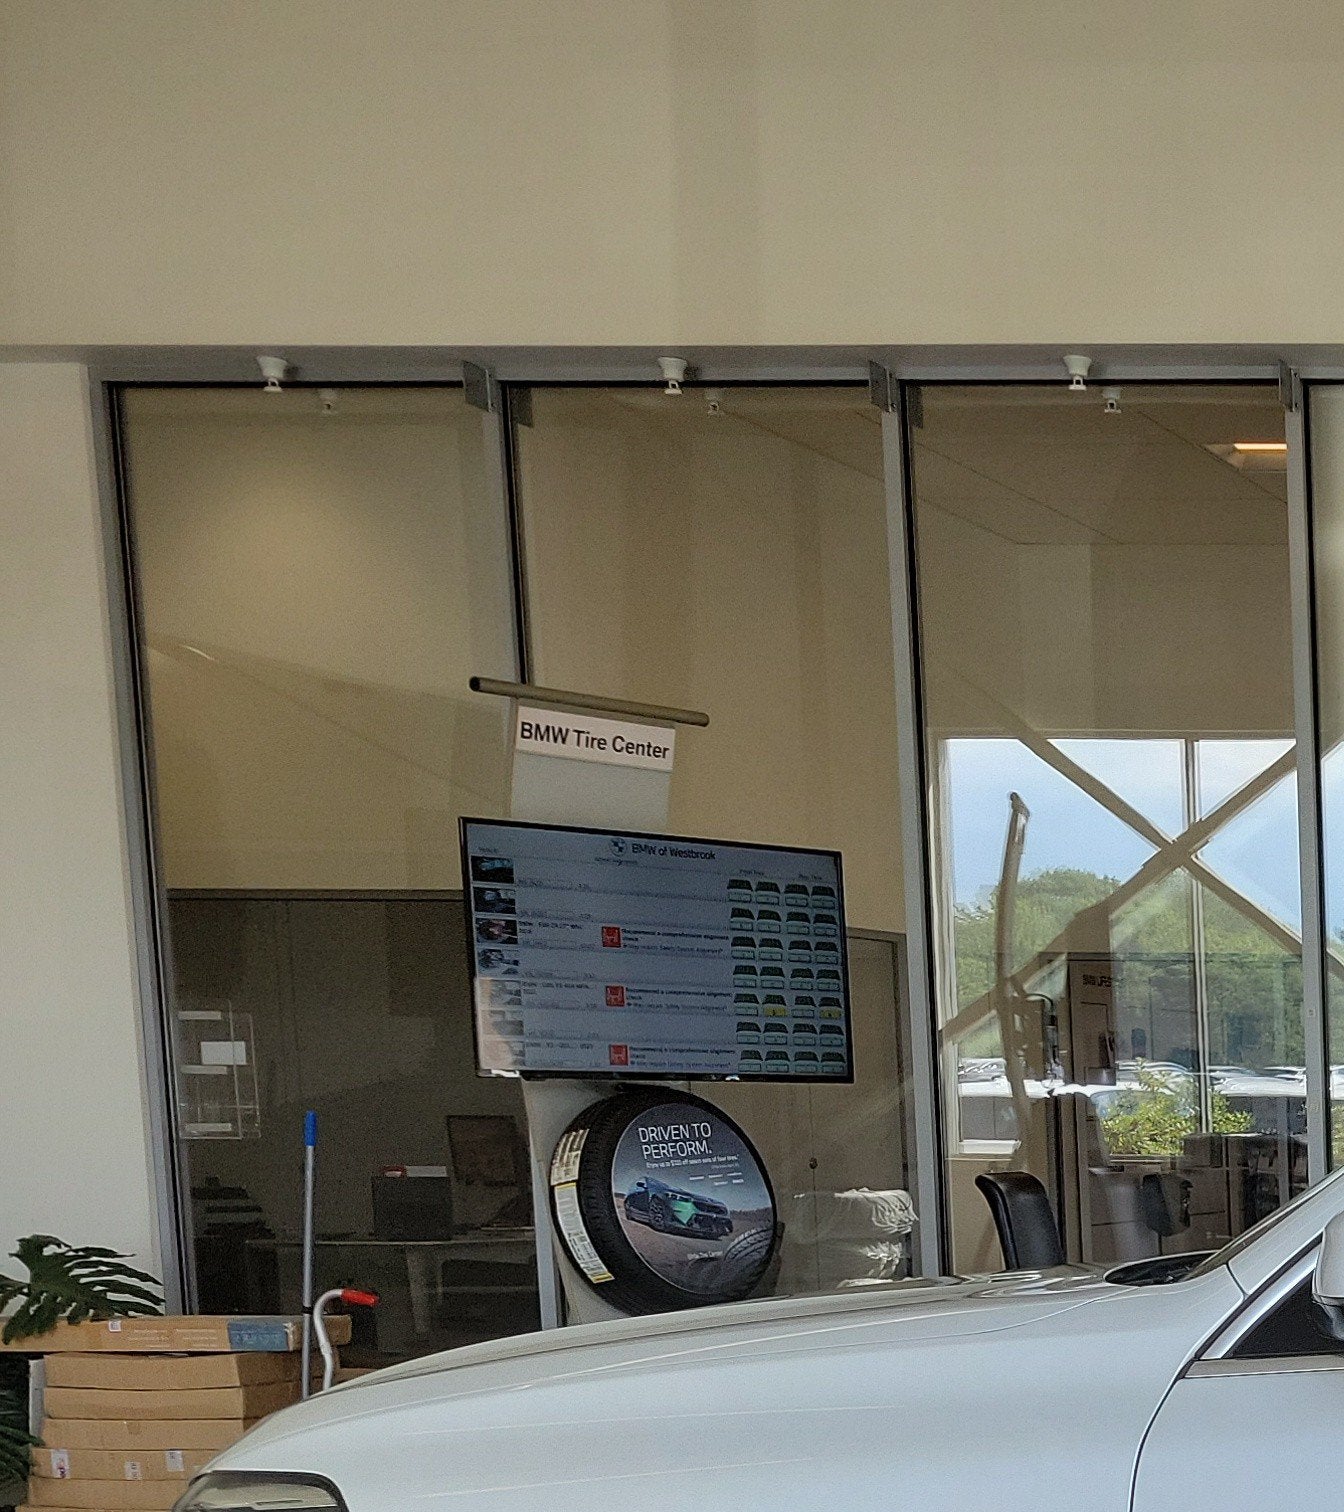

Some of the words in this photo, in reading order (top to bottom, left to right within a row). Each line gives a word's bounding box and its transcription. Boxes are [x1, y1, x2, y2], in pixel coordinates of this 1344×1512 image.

[520, 721, 570, 745] BMW
[572, 729, 608, 751] Tire
[612, 735, 670, 759] Center
[631, 842, 657, 855] BMW
[658, 846, 668, 857] of
[670, 846, 716, 861] Westbrook
[638, 1124, 690, 1143] DRIVEN
[691, 1122, 712, 1139] TO
[642, 1139, 713, 1160] PERFORM.
